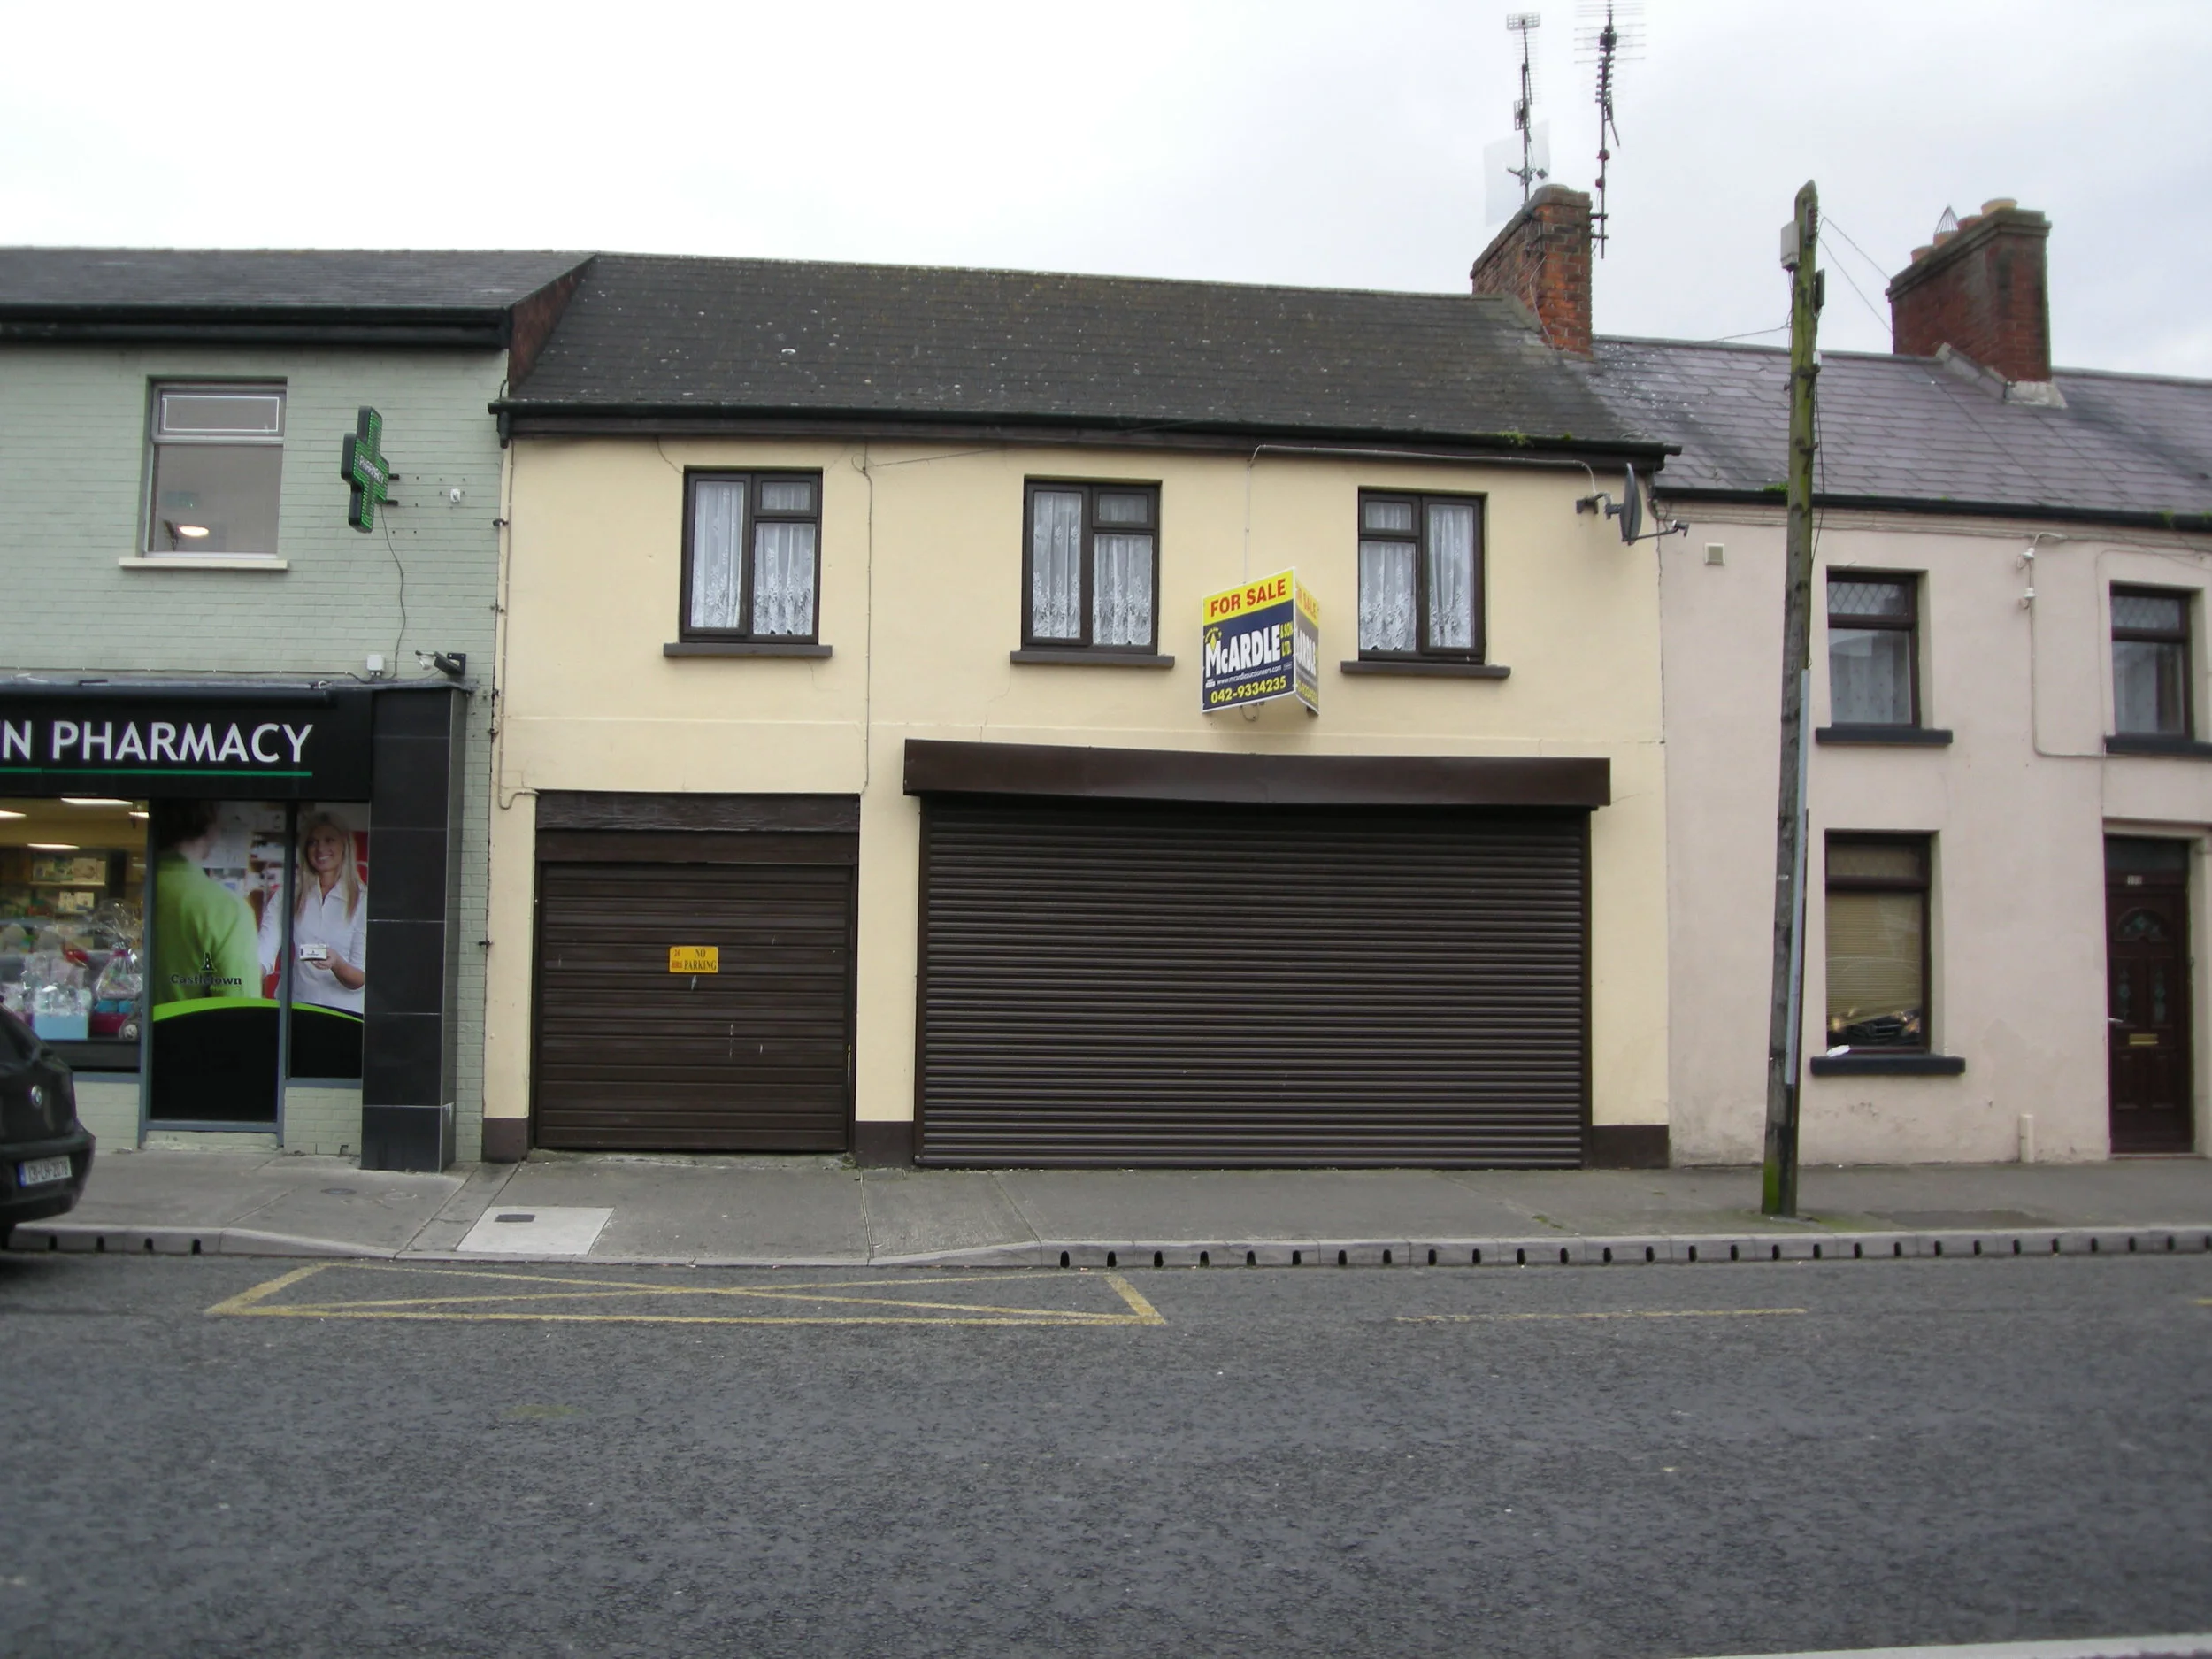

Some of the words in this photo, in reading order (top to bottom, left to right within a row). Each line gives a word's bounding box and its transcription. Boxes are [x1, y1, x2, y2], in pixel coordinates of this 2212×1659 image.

[1210, 592, 1241, 618] FOR
[1246, 578, 1286, 607] SALE
[1205, 624, 1281, 679] McARDLE
[1210, 675, 1286, 704] 042-9334235
[51, 720, 313, 764] PHARMACY
[683, 959, 717, 971] PARKING
[695, 948, 706, 958] NO
